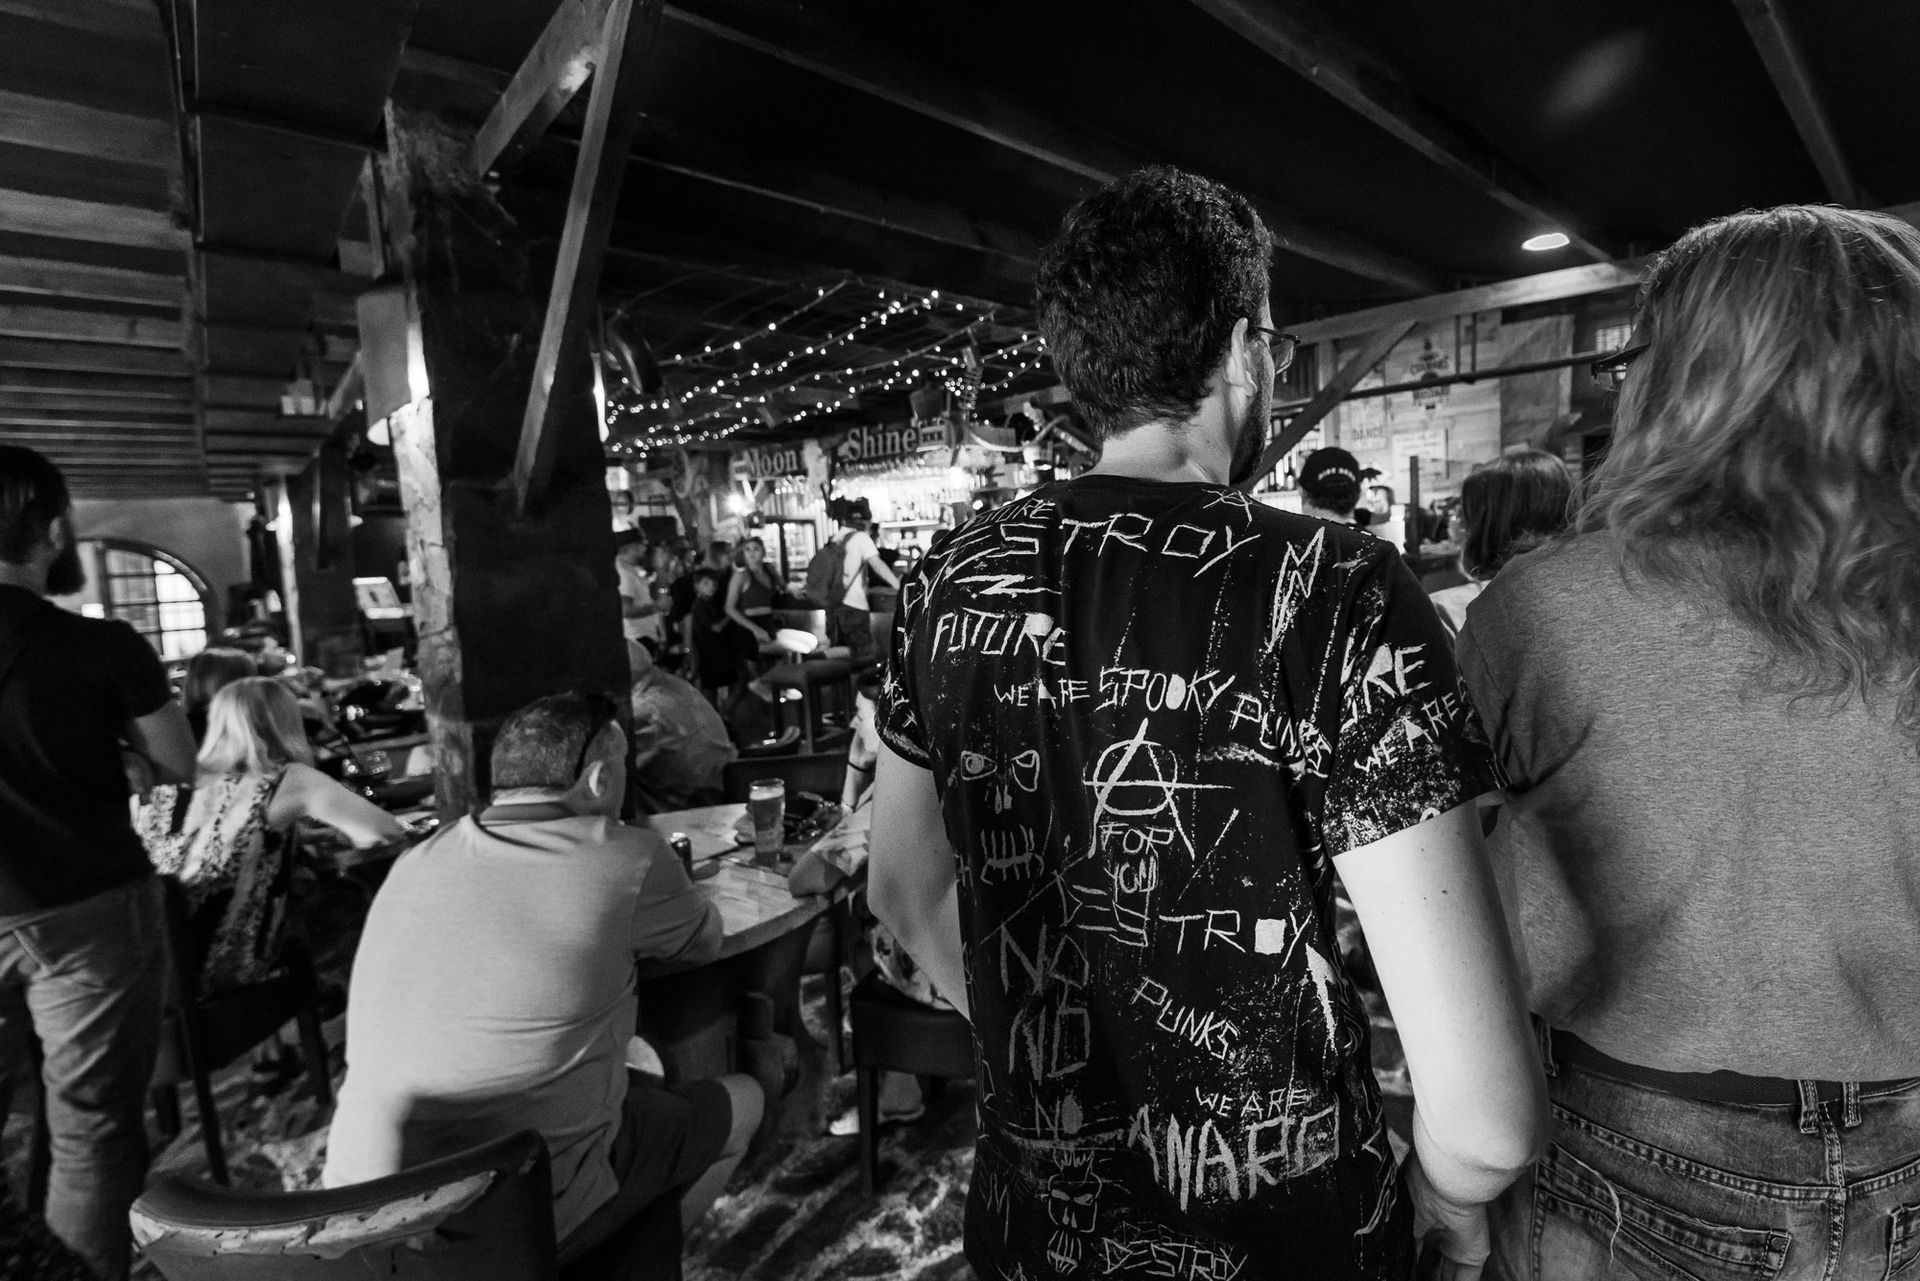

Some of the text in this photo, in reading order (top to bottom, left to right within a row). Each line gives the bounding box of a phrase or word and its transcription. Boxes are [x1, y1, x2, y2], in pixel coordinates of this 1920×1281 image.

[847, 424, 917, 461] Shine
[743, 448, 799, 476] Moon
[931, 607, 1067, 663] FUTURE
[993, 683, 1031, 707] WE
[1094, 666, 1236, 716] SPOOKY
[1098, 822, 1175, 858] FOR
[1131, 976, 1240, 1060] PUNKS
[1195, 1086, 1308, 1120] WE ARE
